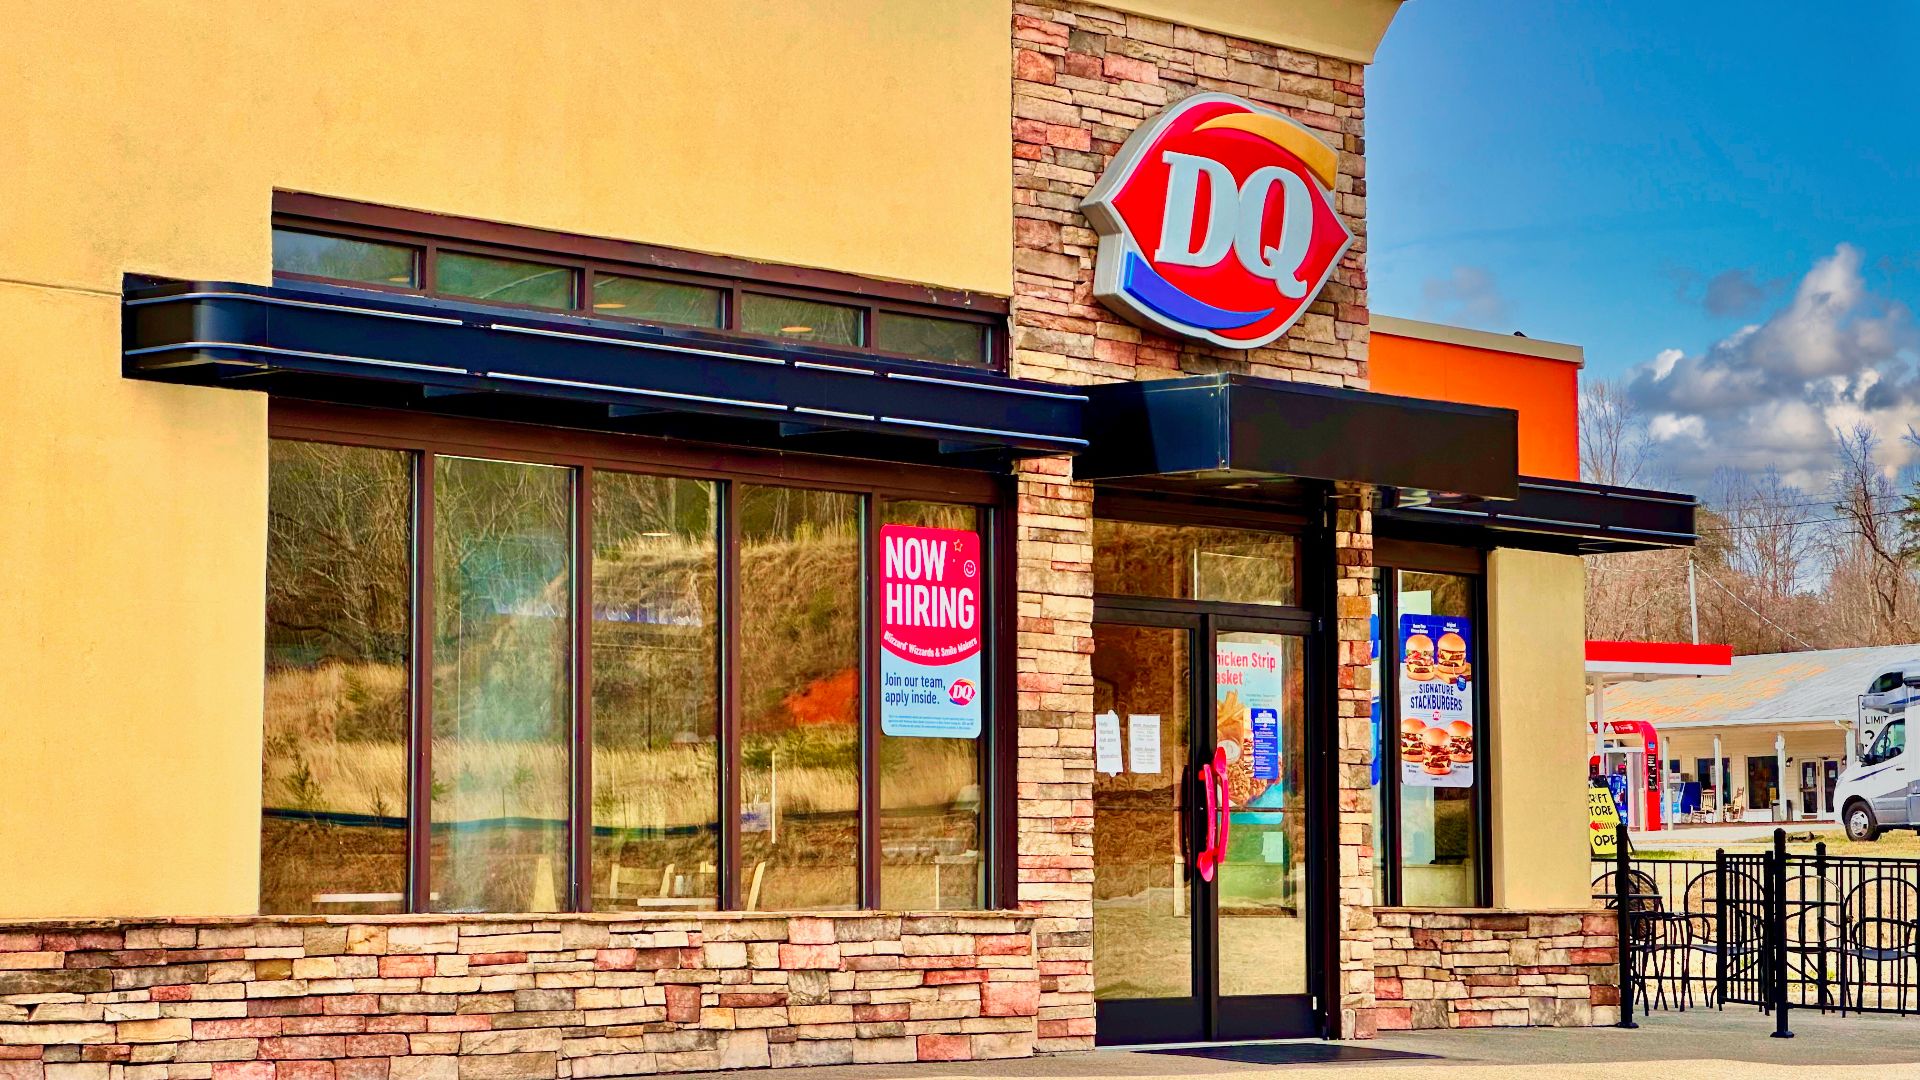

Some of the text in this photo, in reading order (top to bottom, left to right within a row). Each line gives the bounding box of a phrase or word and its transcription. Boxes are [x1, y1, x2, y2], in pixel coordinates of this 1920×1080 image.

[1154, 150, 1307, 299] DQ
[885, 536, 947, 581] NOW
[886, 583, 975, 630] HIRING
[935, 647, 941, 657] &
[941, 646, 957, 657] Smile
[958, 638, 978, 652] Makers
[1251, 652, 1276, 673] Strip
[885, 672, 946, 691] Join our team,
[1217, 670, 1243, 686] asket
[952, 684, 973, 701] DQ
[1418, 683, 1454, 696] SIGNATURE
[885, 690, 940, 706] apply inside.
[1410, 695, 1463, 711] STACKBURGERS
[1865, 716, 1888, 724] LIMIT
[1589, 806, 1613, 816] TORE
[1594, 834, 1618, 847] OPE
